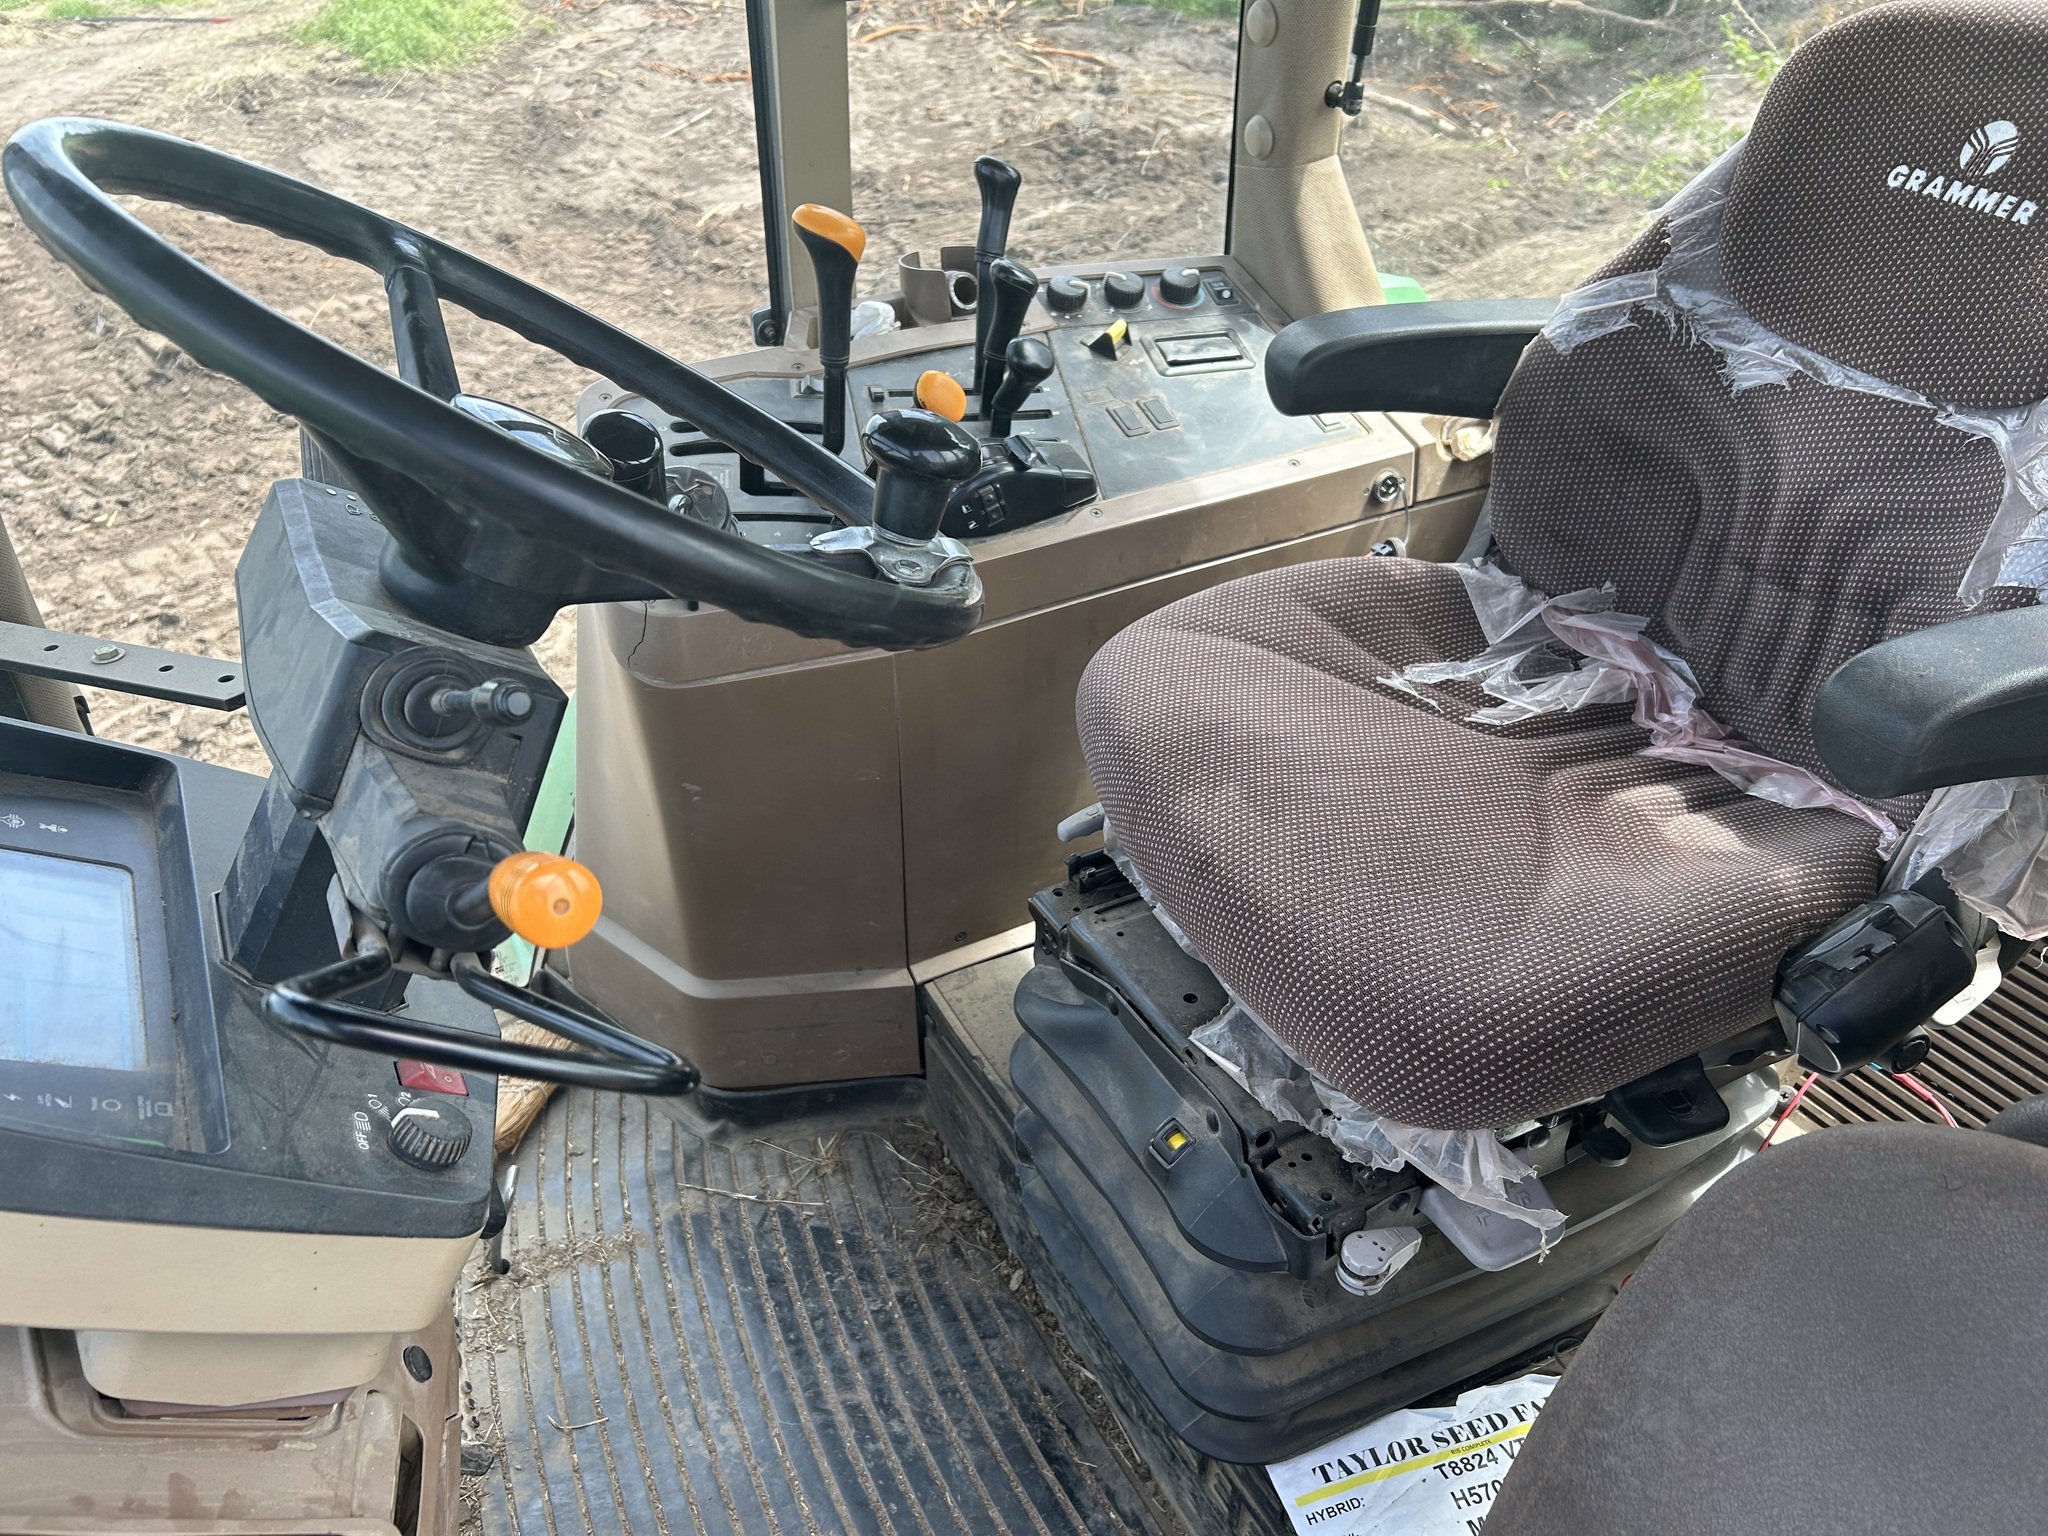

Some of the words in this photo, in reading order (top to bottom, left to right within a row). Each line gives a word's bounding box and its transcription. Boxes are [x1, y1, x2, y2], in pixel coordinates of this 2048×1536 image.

[1887, 164, 2039, 226] GRAMMER
[355, 1131, 370, 1151] OFF
[1311, 1436, 1430, 1485] TAYLOR
[1431, 1412, 1509, 1450] SEED
[1508, 1396, 1549, 1424] FA
[1305, 1497, 1366, 1526] HYBRID:
[1432, 1447, 1499, 1480] T8824
